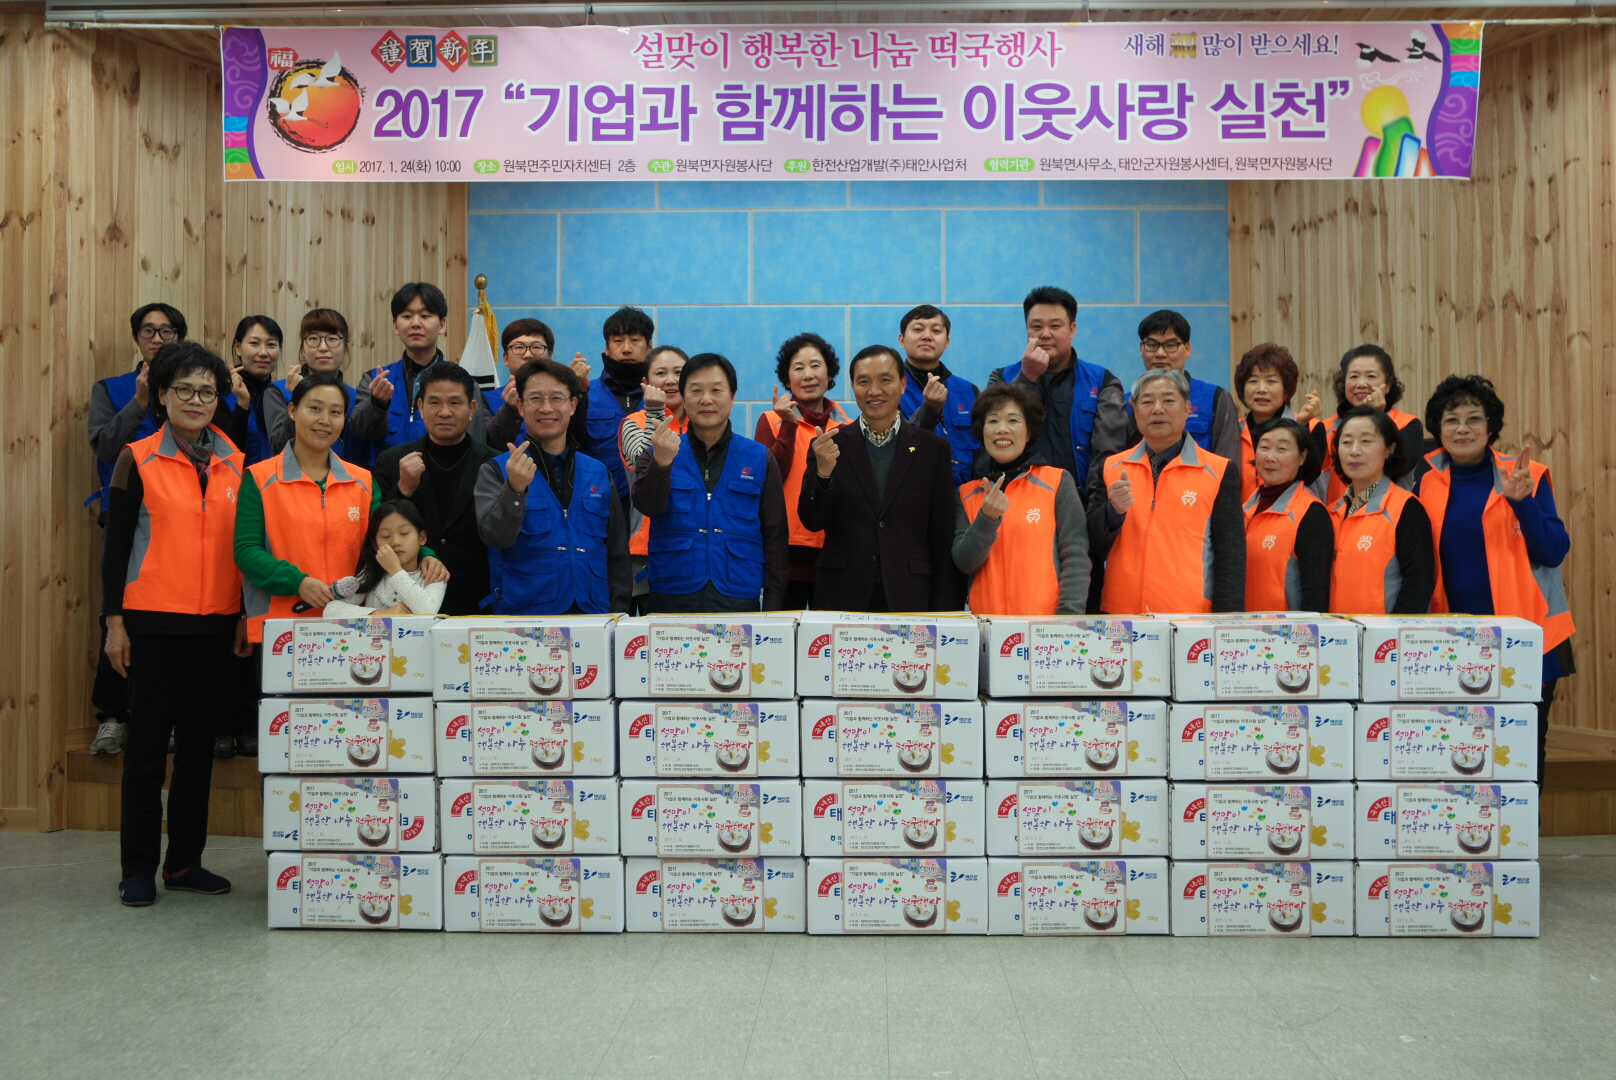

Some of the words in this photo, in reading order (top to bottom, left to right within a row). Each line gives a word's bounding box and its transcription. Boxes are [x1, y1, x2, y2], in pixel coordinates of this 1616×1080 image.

[378, 38, 493, 64] 謹賀新年
[633, 32, 729, 69] 설맞이
[742, 31, 844, 69] 행복한
[850, 31, 919, 69] 나눔
[928, 31, 1063, 68] 떡국행사
[1123, 33, 1165, 57] 새해
[1202, 33, 1242, 57] 많이
[1250, 32, 1339, 57] 받으세요!
[270, 49, 295, 68] 福
[373, 88, 484, 139] 2017
[504, 82, 698, 143] “기업과
[715, 83, 943, 142] 함께하는
[963, 82, 1194, 141] 이웃사랑
[1210, 79, 1350, 141] 실천”
[335, 161, 354, 172] 일시
[359, 160, 385, 173] 2017.
[388, 160, 398, 173] 1.
[400, 159, 432, 174] 24(화)
[435, 160, 461, 173] 10:00
[476, 161, 497, 172] 장소
[503, 159, 611, 173] 원북면주민자치센터
[617, 159, 637, 173] 2층
[650, 160, 671, 172] 주관
[676, 159, 773, 173] 원북면자원봉사단
[787, 160, 808, 172] 후원
[812, 159, 967, 172] 한전산업개발(주)태안사업처
[988, 159, 1030, 171] 협력기관
[1039, 157, 1116, 172] 원북면사무소,
[1118, 157, 1233, 172] 태안군자원봉사센터,
[1235, 157, 1332, 171] 원북면자원봉사단
[298, 643, 325, 653] 설맞이
[628, 638, 644, 654] 국내산
[1004, 635, 1020, 651] 국내산
[1190, 641, 1206, 657] 국내산
[654, 647, 682, 658] 설맞이
[838, 648, 866, 659] 설맞이
[1035, 645, 1063, 655] 설맞이
[1220, 650, 1248, 661] 설맞이
[1404, 651, 1432, 661] 설맞이
[297, 654, 324, 667] 행복한
[348, 653, 386, 666] 떡국행사
[474, 652, 502, 662] 설맞이
[1035, 656, 1062, 669] 행복한
[1088, 656, 1128, 669] 떡국행사
[474, 663, 501, 675] 행복한
[526, 663, 566, 675] 떡국행사
[654, 659, 681, 672] 행복한
[707, 660, 746, 672] 떡국행사
[837, 659, 865, 672] 행복한
[891, 661, 931, 673] 떡국행사
[1220, 661, 1248, 674] 행복한
[1274, 661, 1314, 673] 떡국행사
[1403, 662, 1431, 675] 행복한
[1456, 662, 1496, 675] 떡국행사
[294, 724, 321, 734] 설맞이
[477, 726, 505, 737] 설맞이
[815, 717, 831, 733] 국내산
[1029, 726, 1057, 737] 설맞이
[661, 727, 689, 738] 설맞이
[842, 728, 871, 738] 설맞이
[1210, 730, 1238, 741] 설맞이
[1395, 730, 1424, 741] 설맞이
[294, 735, 320, 748] 행복한
[345, 734, 383, 747] 떡국행사
[477, 738, 504, 751] 행복한
[529, 737, 568, 750] 떡국행사
[661, 739, 688, 751] 행복한
[714, 739, 753, 751] 떡국행사
[842, 739, 870, 752] 행복한
[896, 740, 936, 752] 떡국행사
[1029, 738, 1057, 751] 행복한
[1082, 738, 1122, 751] 떡국행사
[1210, 742, 1237, 755] 행복한
[1263, 742, 1304, 754] 떡국행사
[1395, 742, 1423, 754] 행복한
[1449, 742, 1489, 755] 떡국행사
[305, 802, 332, 813] 설맞이
[454, 795, 470, 811] 국내산
[1371, 799, 1387, 815] 국내산
[478, 805, 505, 816] 설맞이
[662, 808, 690, 819] 설맞이
[848, 805, 876, 816] 설맞이
[1023, 806, 1051, 817] 설맞이
[1212, 810, 1240, 821] 설맞이
[1402, 809, 1430, 820] 설맞이
[305, 814, 331, 826] 행복한
[355, 814, 393, 826] 떡국행사
[478, 817, 505, 829] 행복한
[530, 817, 569, 829] 떡국행사
[662, 820, 689, 832] 행복한
[715, 820, 755, 832] 떡국행사
[848, 817, 875, 830] 행복한
[901, 817, 941, 829] 떡국행사
[1023, 817, 1050, 831] 행복한
[1076, 817, 1116, 830] 떡국행사
[1212, 822, 1239, 835] 행복한
[1265, 823, 1306, 835] 떡국행사
[1401, 821, 1429, 833] 행복한
[1455, 821, 1495, 834] 떡국행사
[306, 878, 333, 889] 설맞이
[484, 883, 512, 893] 설맞이
[667, 883, 695, 894] 설맞이
[848, 883, 876, 893] 설맞이
[306, 890, 332, 903] 행복한
[357, 891, 395, 904] 떡국행사
[1028, 886, 1056, 897] 설맞이
[1213, 888, 1241, 899] 설맞이
[1394, 888, 1422, 899] 설맞이
[484, 894, 511, 907] 행복한
[537, 895, 576, 907] 떡국행사
[667, 894, 694, 907] 행복한
[720, 894, 759, 907] 떡국행사
[848, 895, 875, 907] 행복한
[901, 895, 941, 907] 떡국행사
[1028, 898, 1055, 911] 행복한
[1081, 897, 1121, 910] 떡국행사
[1213, 900, 1240, 913] 행복한
[1266, 899, 1306, 912] 떡국행사
[1394, 900, 1422, 912] 행복한
[1448, 899, 1488, 912] 떡국행사
